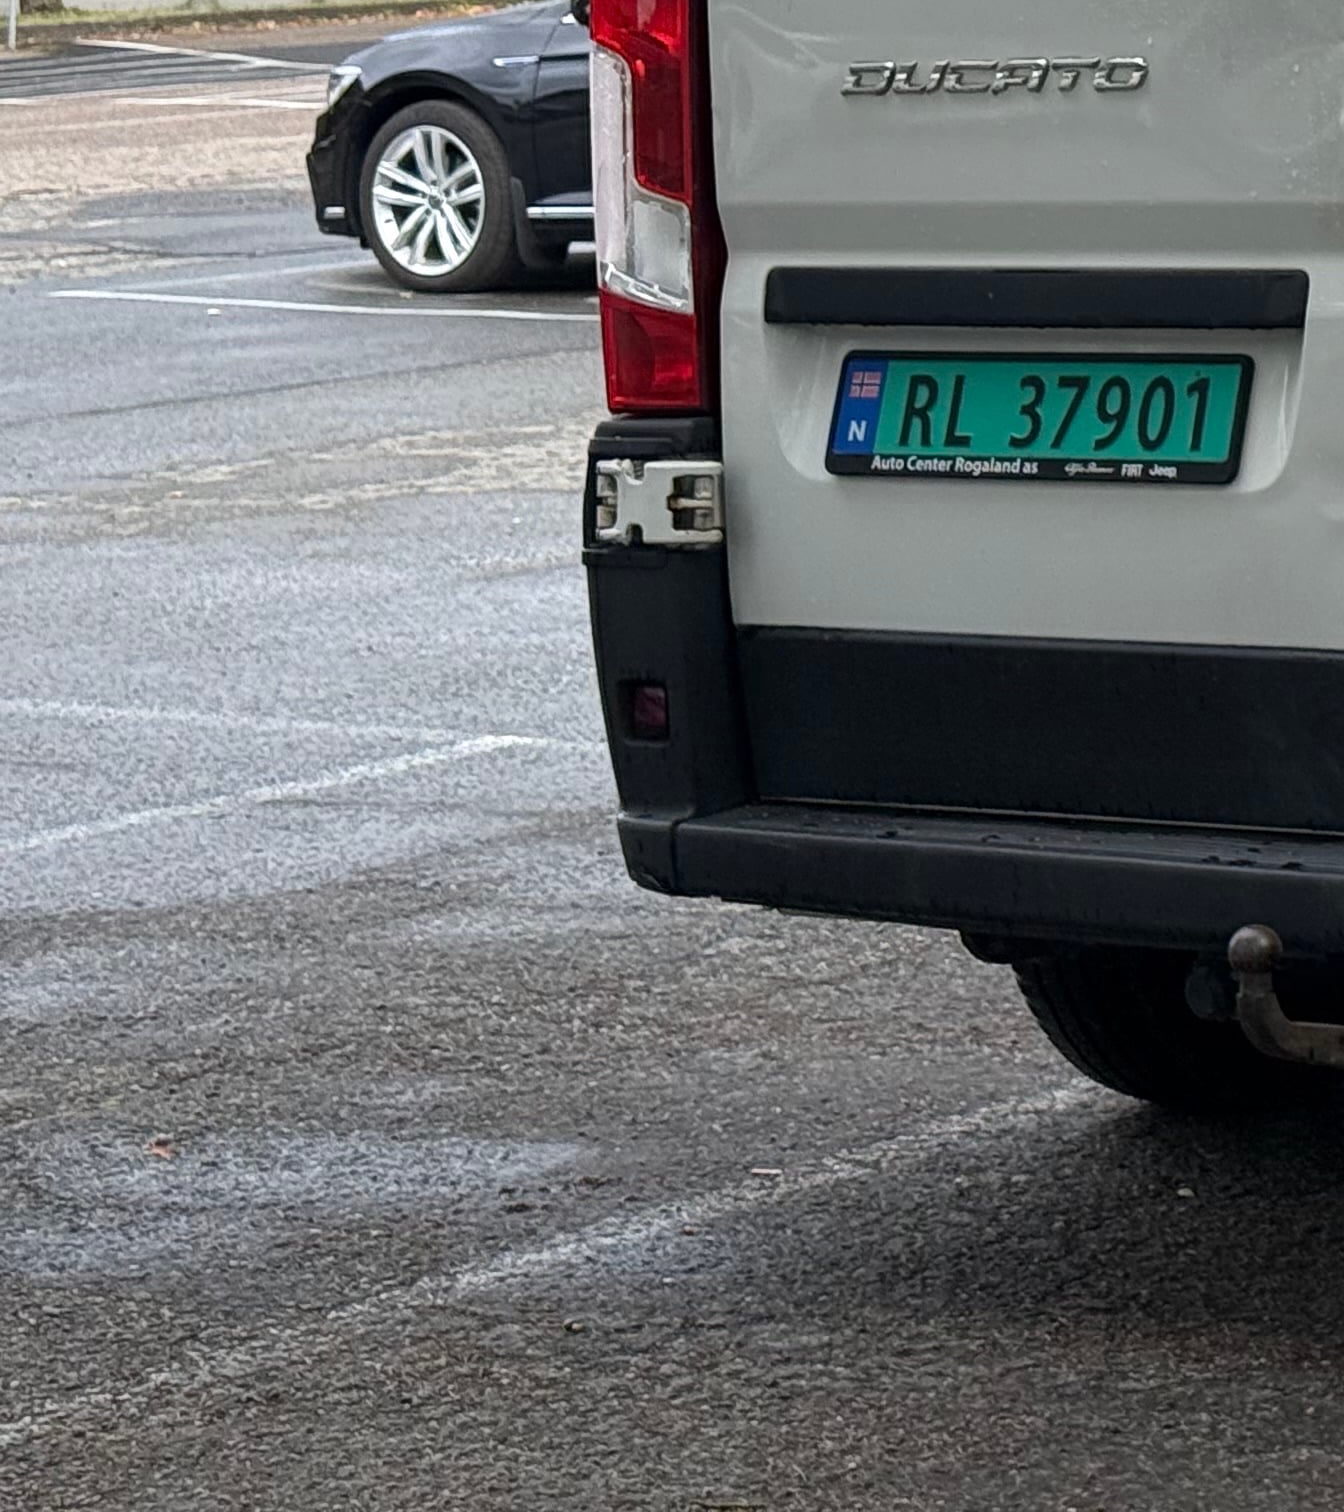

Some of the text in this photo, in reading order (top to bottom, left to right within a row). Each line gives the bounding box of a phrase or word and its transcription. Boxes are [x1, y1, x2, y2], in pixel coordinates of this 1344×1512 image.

[841, 55, 1149, 96] DUCATO
[897, 373, 1215, 453] RL 37901
[846, 419, 867, 442] N
[871, 454, 1039, 477] Auto Center Rogaland as
[1120, 463, 1144, 478] FIAT
[1148, 463, 1178, 479] Jeep
